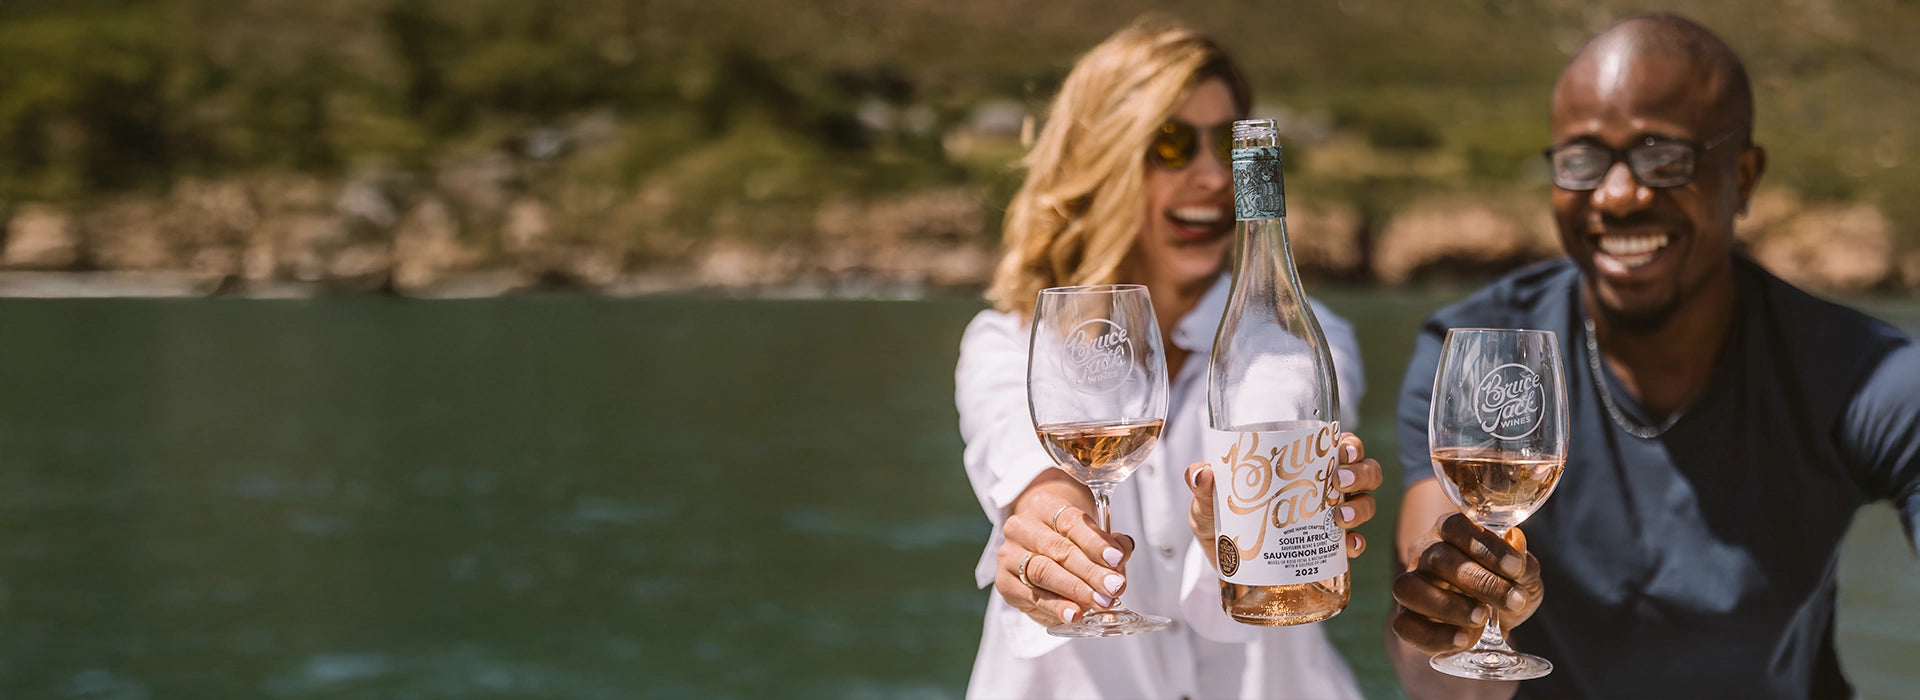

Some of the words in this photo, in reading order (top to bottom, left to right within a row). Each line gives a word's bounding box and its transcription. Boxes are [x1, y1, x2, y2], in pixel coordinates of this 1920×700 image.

[1066, 328, 1128, 364] Bruce
[1481, 374, 1541, 407] Bruce
[1481, 391, 1538, 432] Jack
[1501, 415, 1531, 428] WINES
[1221, 421, 1341, 503] Bruce
[1227, 456, 1341, 562] Jack
[1264, 550, 1317, 559] SAUVIGNON
[1319, 543, 1340, 554] BLUSH
[1279, 537, 1305, 546] SOUTH
[1307, 532, 1328, 542] AFRICA
[1296, 567, 1319, 576] 2023
